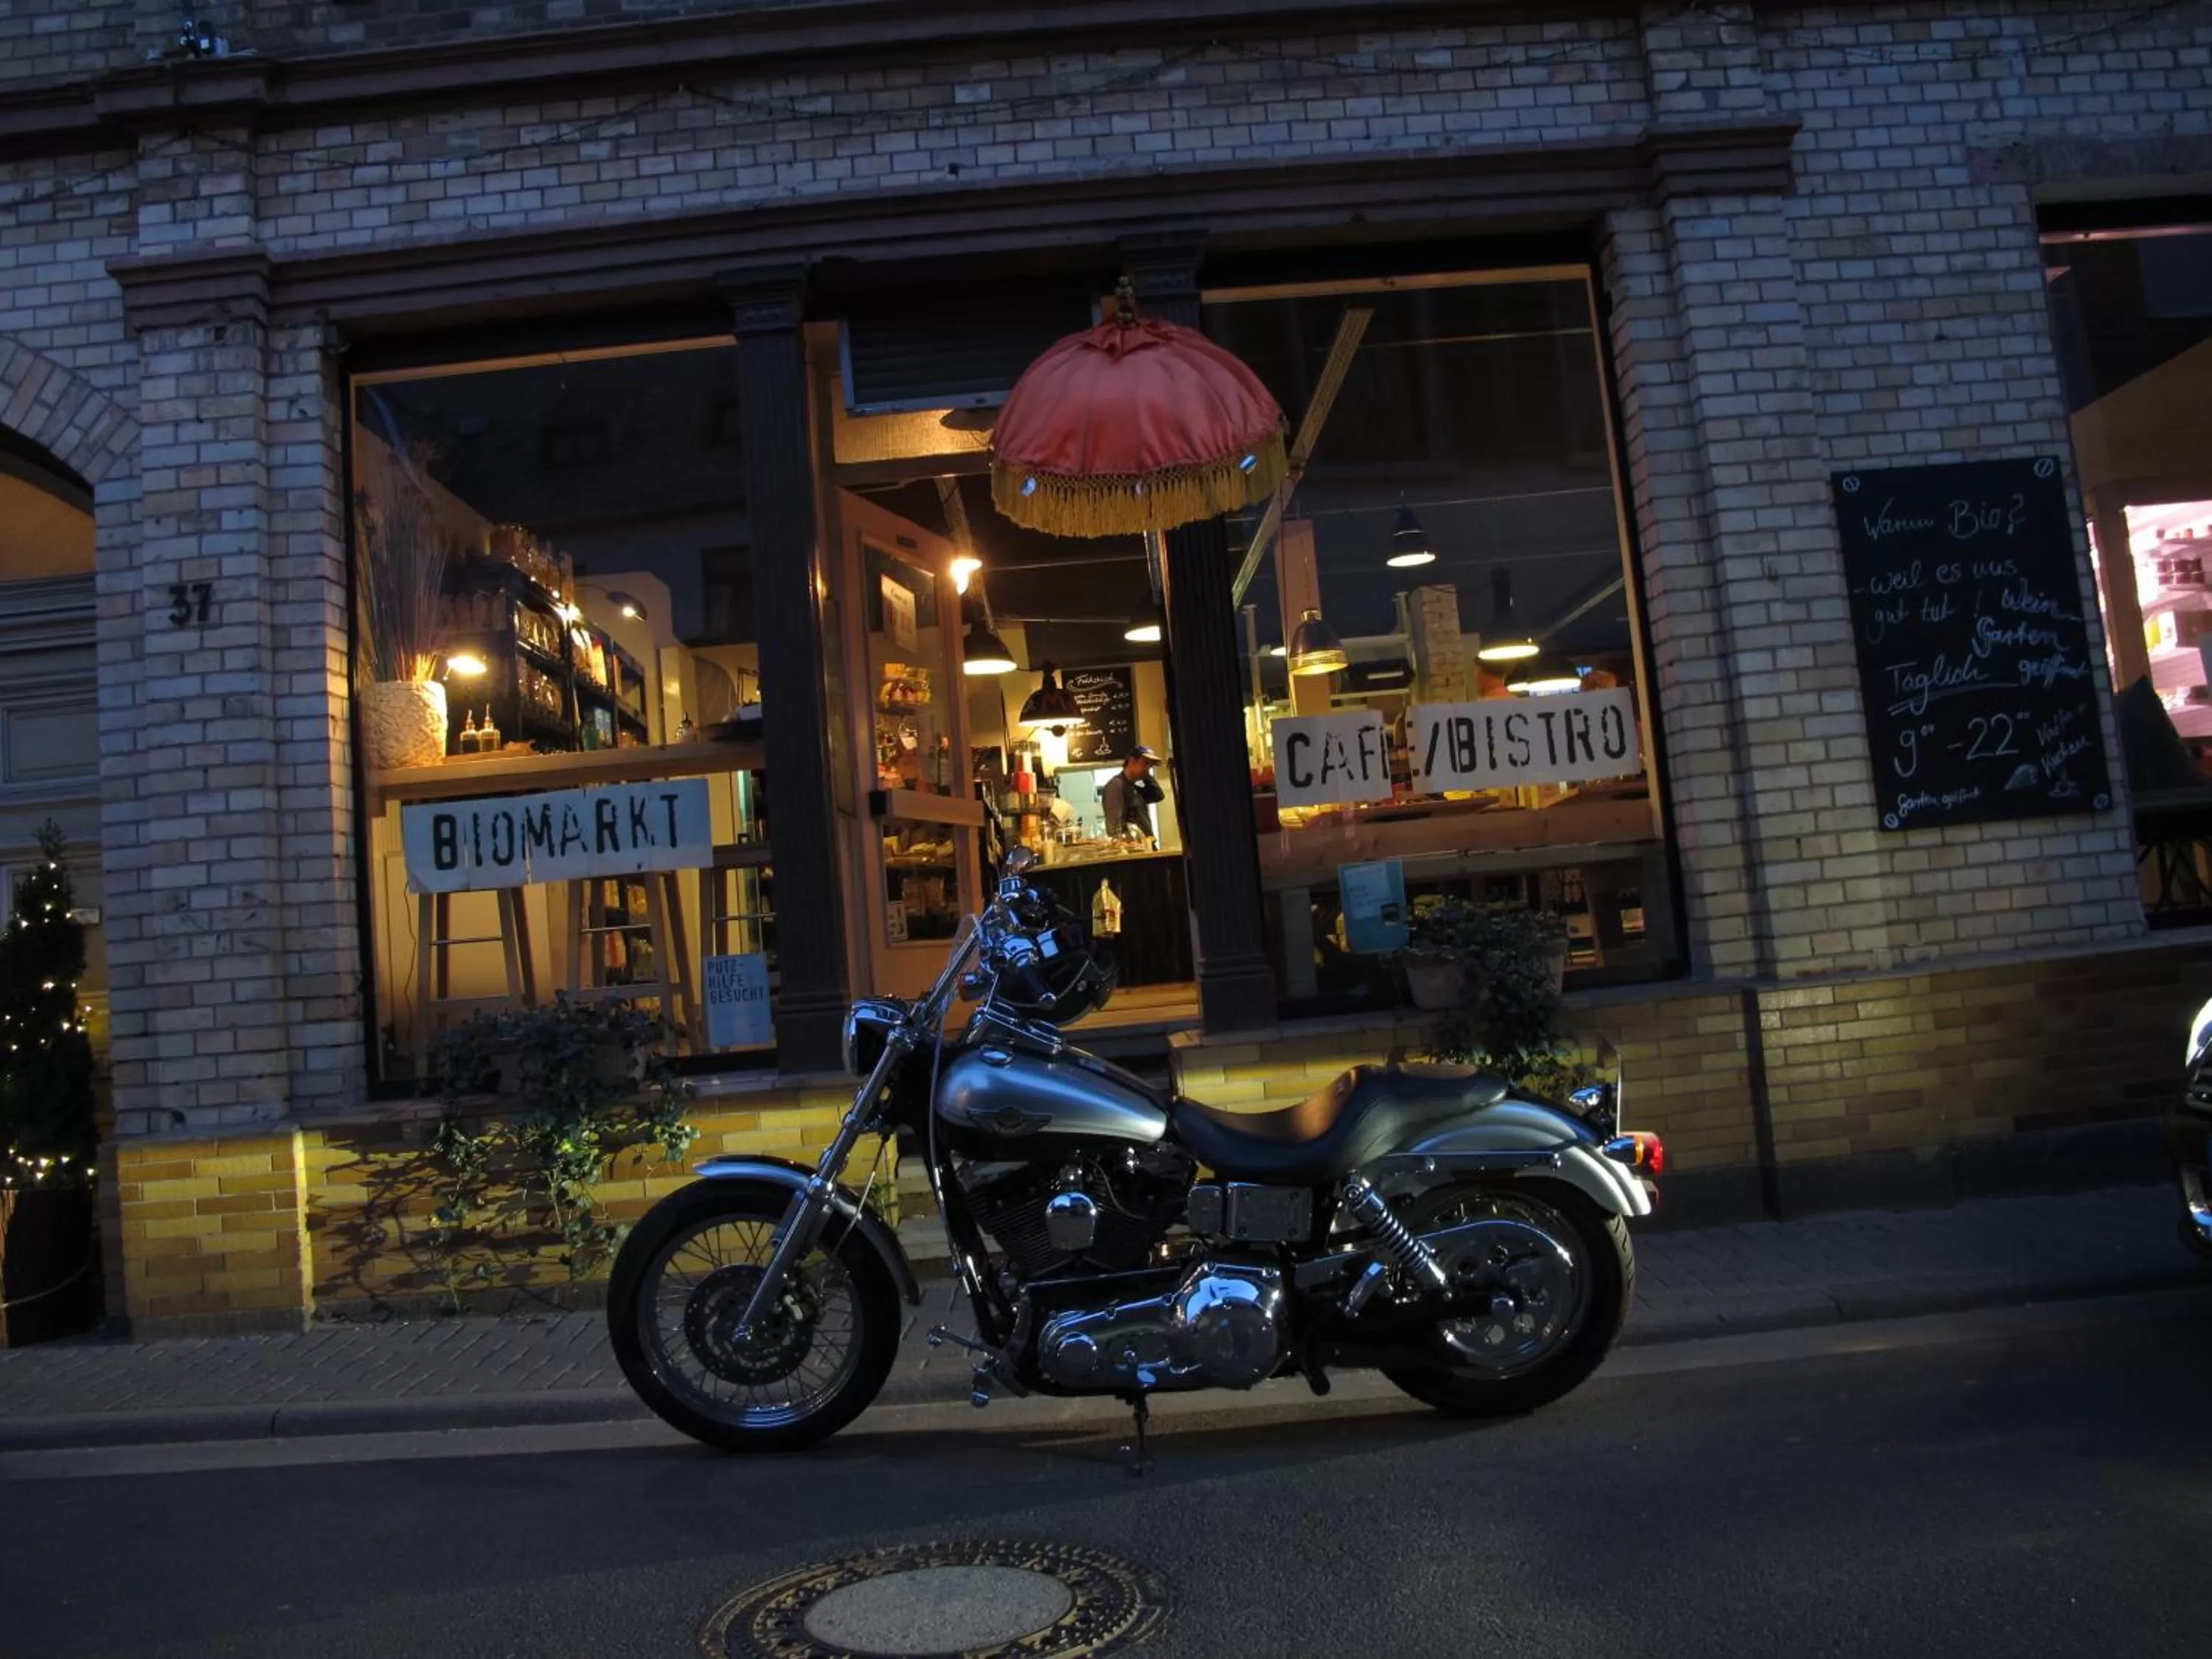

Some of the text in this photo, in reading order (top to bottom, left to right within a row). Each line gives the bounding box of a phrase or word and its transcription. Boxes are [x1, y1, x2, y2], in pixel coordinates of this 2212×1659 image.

[1947, 492, 2026, 540] Bio?
[1870, 559, 1925, 594] weil
[1935, 561, 1961, 584] es
[1865, 597, 1910, 644] gut
[433, 794, 678, 871] BIOMARKT
